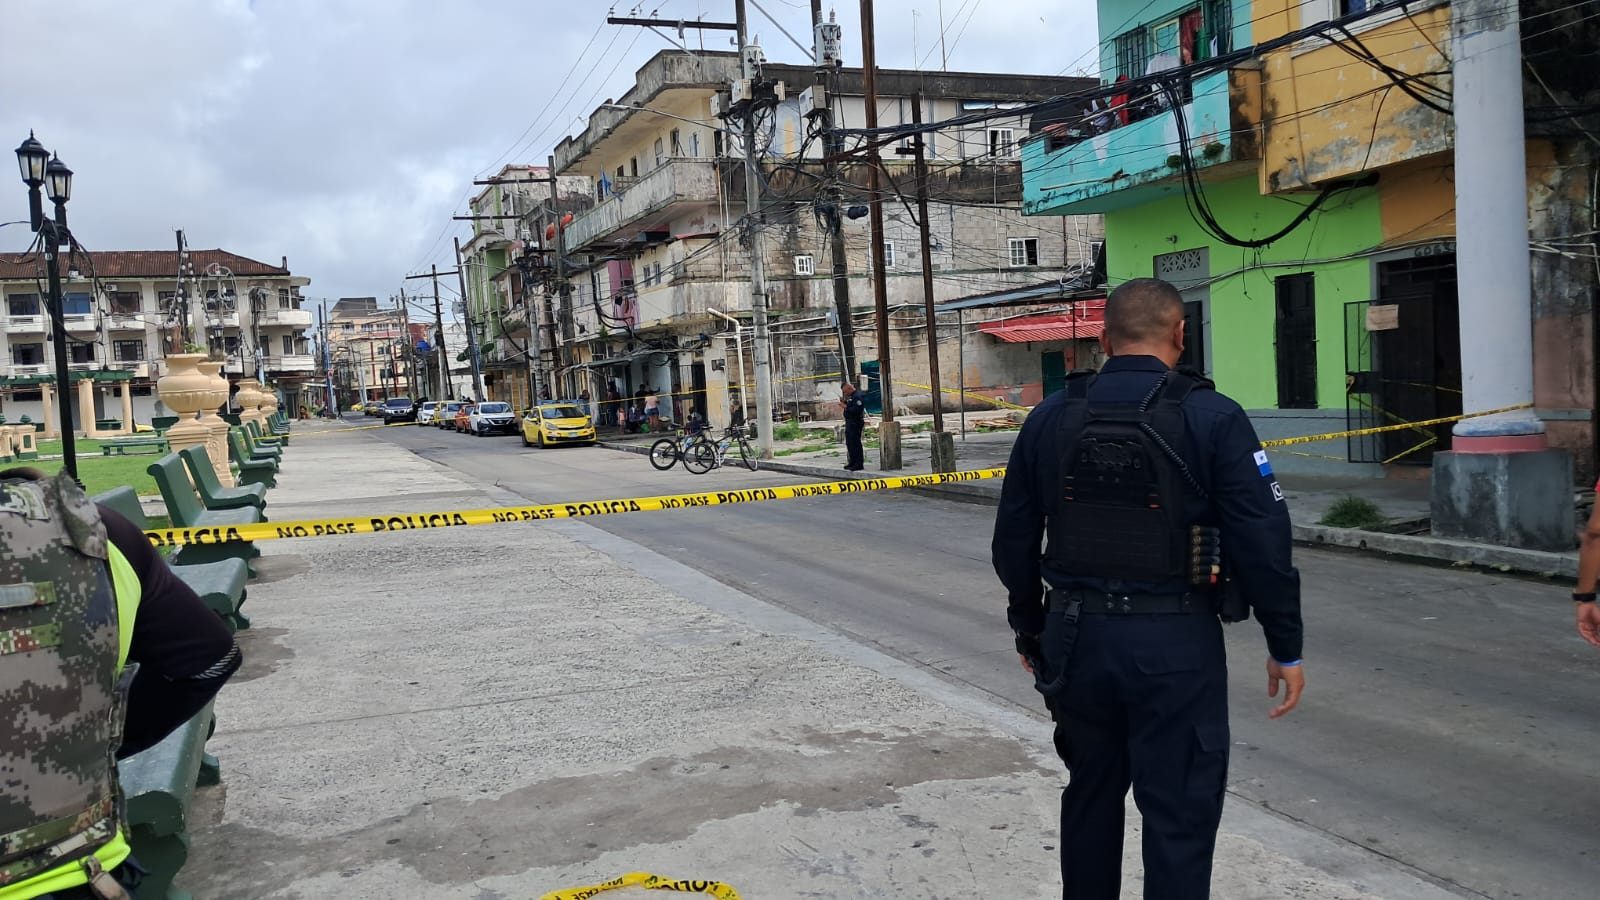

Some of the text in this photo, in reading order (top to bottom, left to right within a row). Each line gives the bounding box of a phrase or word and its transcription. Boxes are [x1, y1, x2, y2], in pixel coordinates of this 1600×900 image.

[144, 527, 252, 546] OLICIA
[276, 526, 308, 538] NO
[313, 523, 356, 536] PASE
[370, 513, 467, 531] POLICIA
[492, 511, 518, 522] NO
[521, 509, 555, 520] PASE
[565, 500, 641, 517] POLICIA
[660, 499, 680, 509] NO
[682, 496, 709, 507] PASE
[717, 489, 776, 504] POLICIA
[792, 487, 808, 497] NO
[811, 485, 832, 496] PASE
[838, 480, 887, 492] POLICIA
[901, 478, 914, 488] NO
[939, 471, 980, 483] POLICIA
